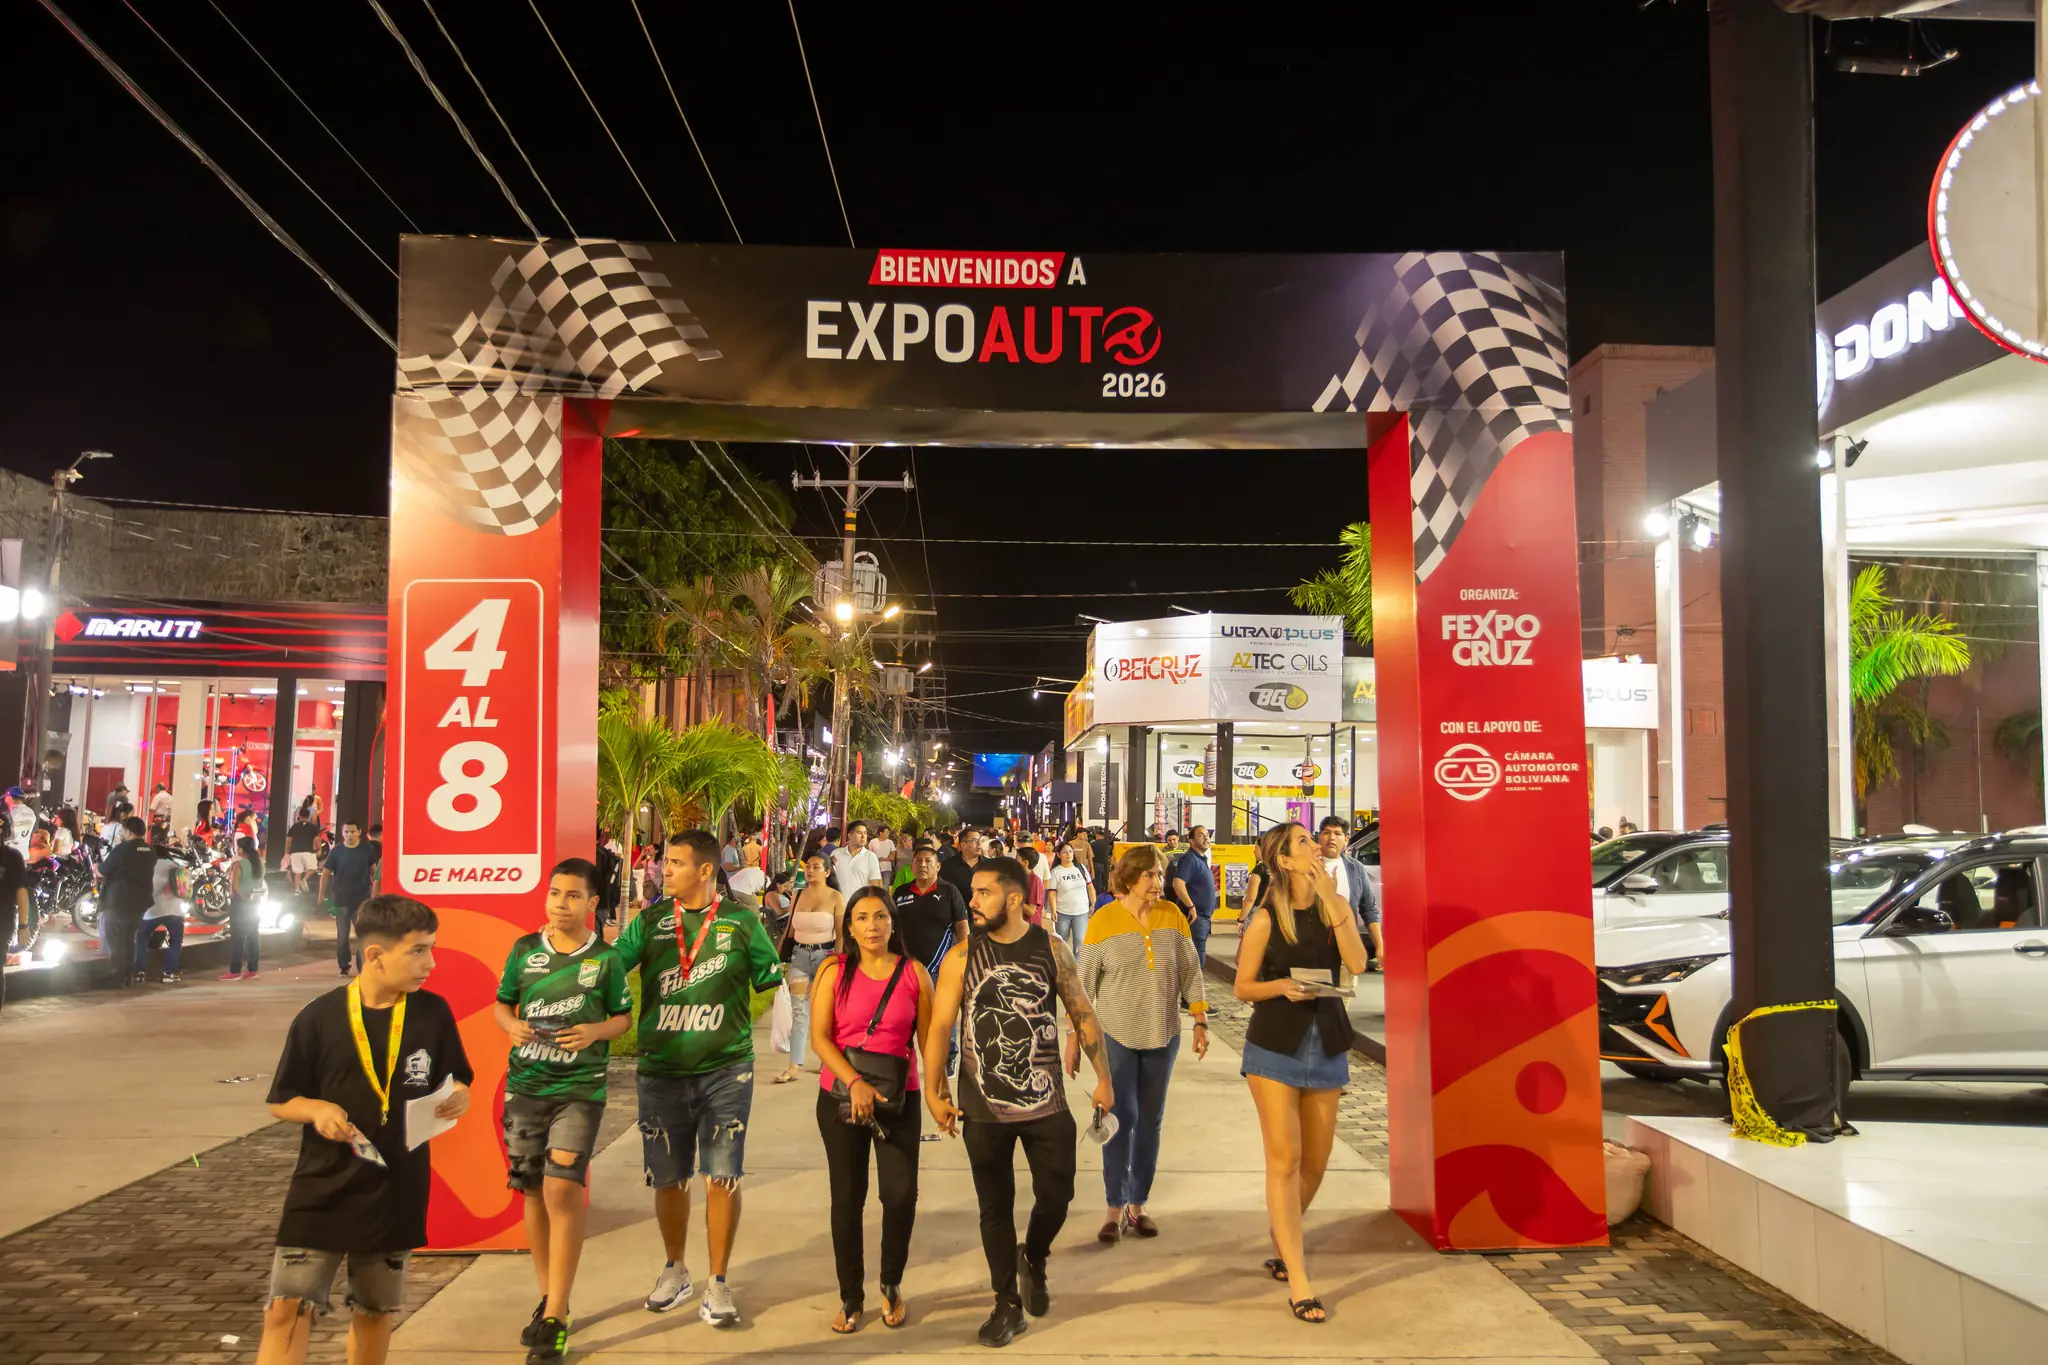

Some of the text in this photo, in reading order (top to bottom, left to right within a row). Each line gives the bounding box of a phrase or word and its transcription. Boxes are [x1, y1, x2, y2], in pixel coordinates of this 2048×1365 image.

[879, 256, 1087, 286] BIENVENIDOS A
[1834, 277, 1967, 381] DON
[1102, 372, 1166, 398] 2026
[1459, 588, 1520, 601] ORGANIZA:
[84, 617, 203, 639] MARUTI
[1221, 625, 1270, 638] ULTRA
[1441, 609, 1540, 640] FEXPO
[424, 598, 511, 687] 4
[1451, 639, 1533, 666] CRUZ
[1230, 652, 1328, 671] AZTEC OILS
[1254, 689, 1288, 706] BG
[436, 696, 499, 728] AL
[1440, 720, 1542, 734] CON EL APOYO DE:
[1504, 750, 1554, 761] CÁMARA
[1177, 763, 1196, 775] BG
[1237, 765, 1257, 777] BG
[1504, 763, 1579, 772] AUTOMOTOR
[426, 740, 509, 832] 8
[1505, 774, 1570, 784] BOLIVIANA
[413, 867, 523, 883] DE MARZO
[526, 994, 586, 1017] Finesse
[656, 1003, 725, 1031] YANGO
